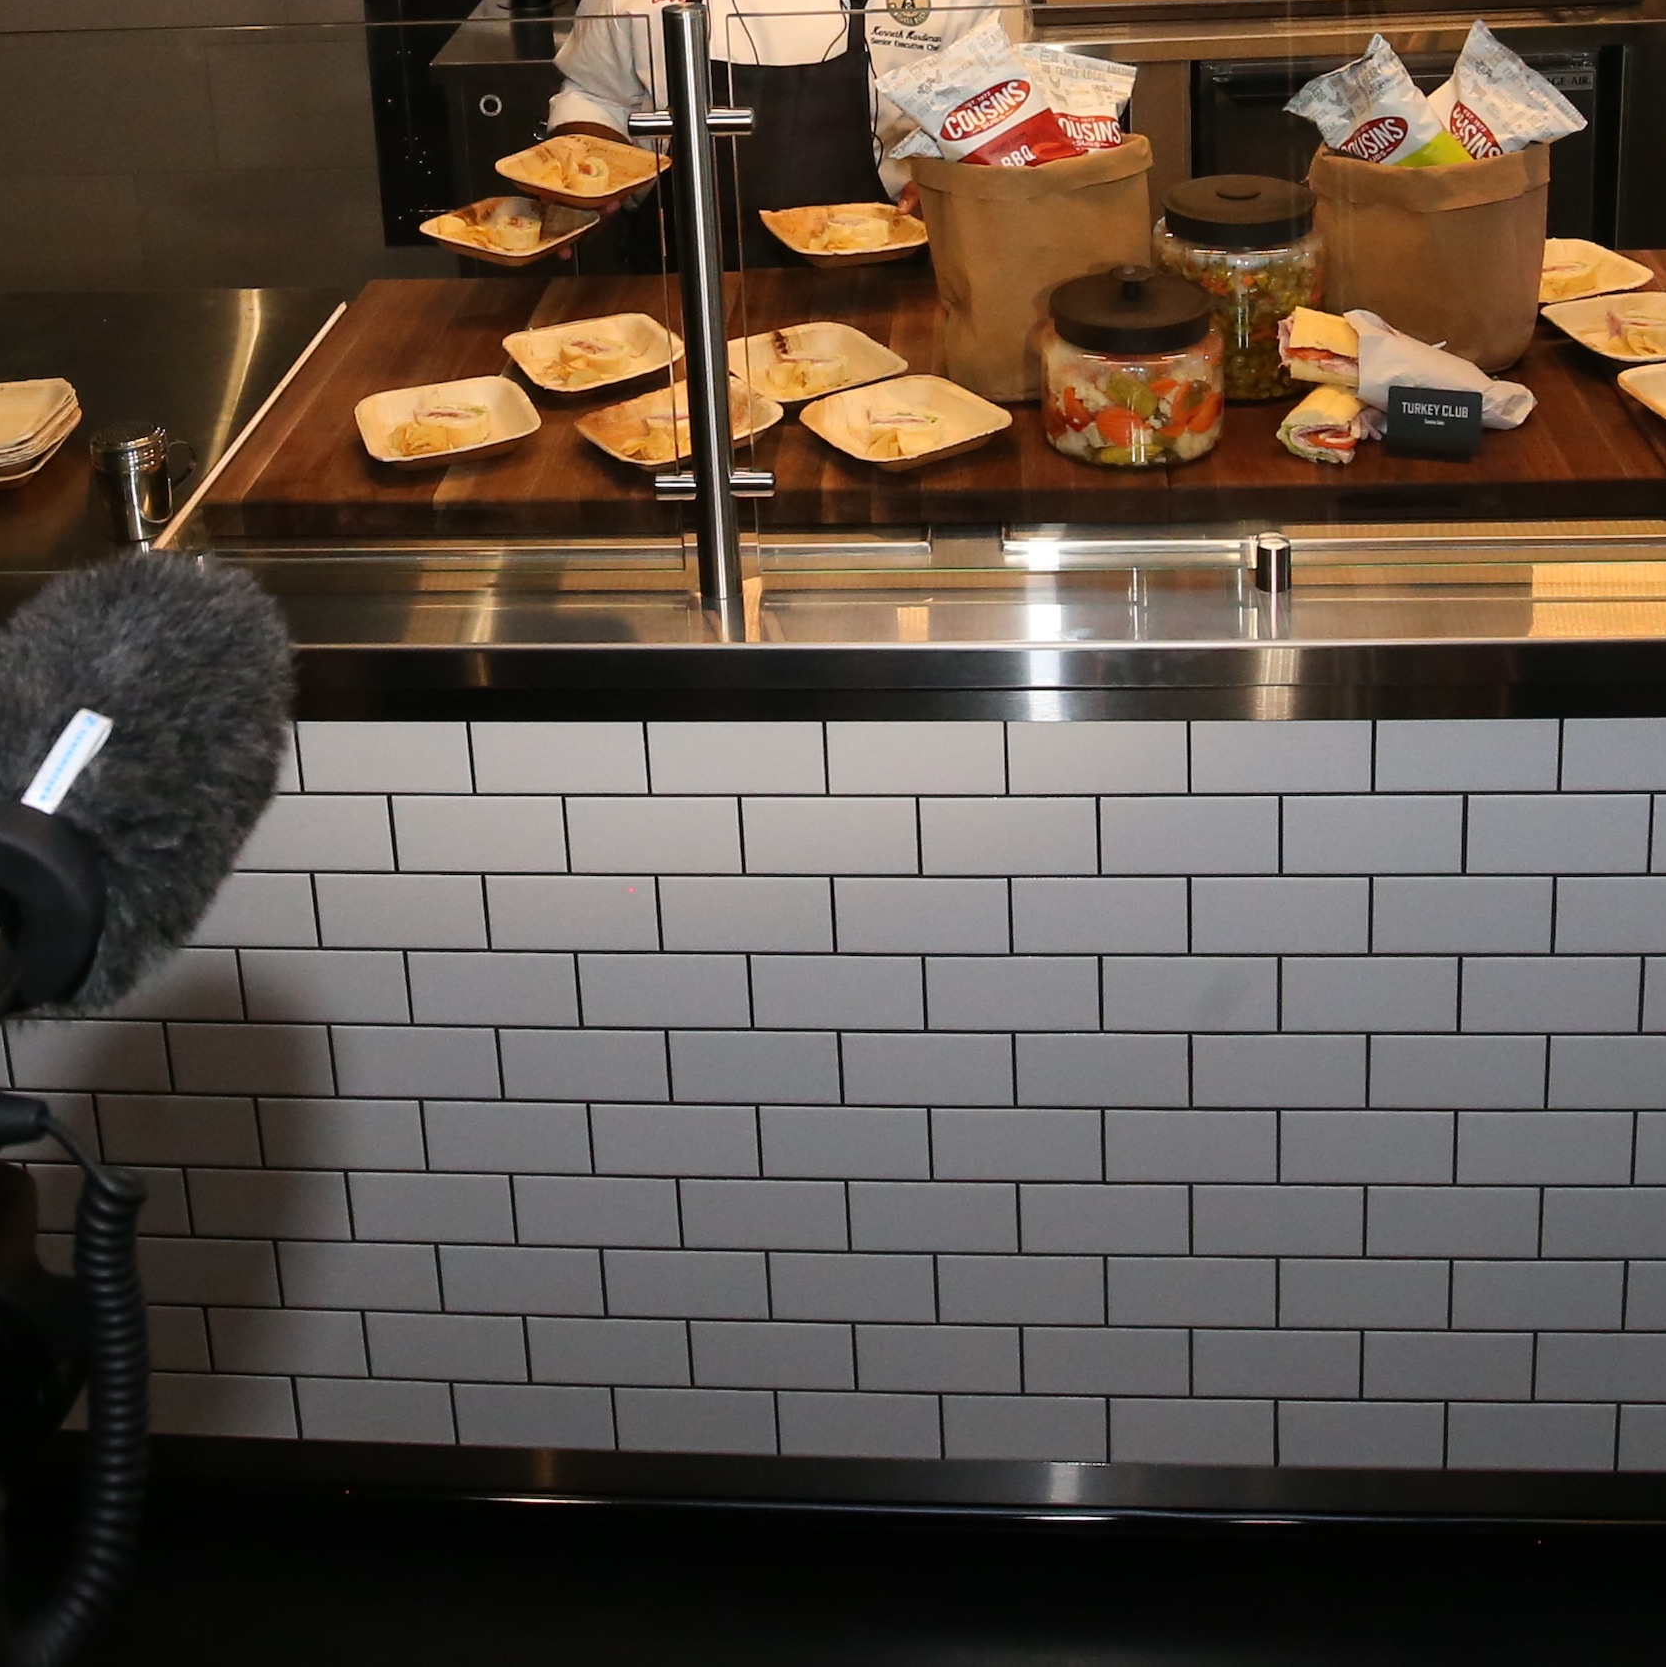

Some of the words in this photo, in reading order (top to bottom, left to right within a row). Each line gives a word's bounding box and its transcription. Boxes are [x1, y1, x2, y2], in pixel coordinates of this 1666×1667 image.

[871, 38, 893, 47] Senior
[894, 40, 925, 51] Executive
[945, 81, 1027, 139] COUSINS
[1058, 117, 1122, 144] OUSINS
[1402, 402, 1440, 416] TURKEY
[1442, 405, 1469, 419] CLUB
